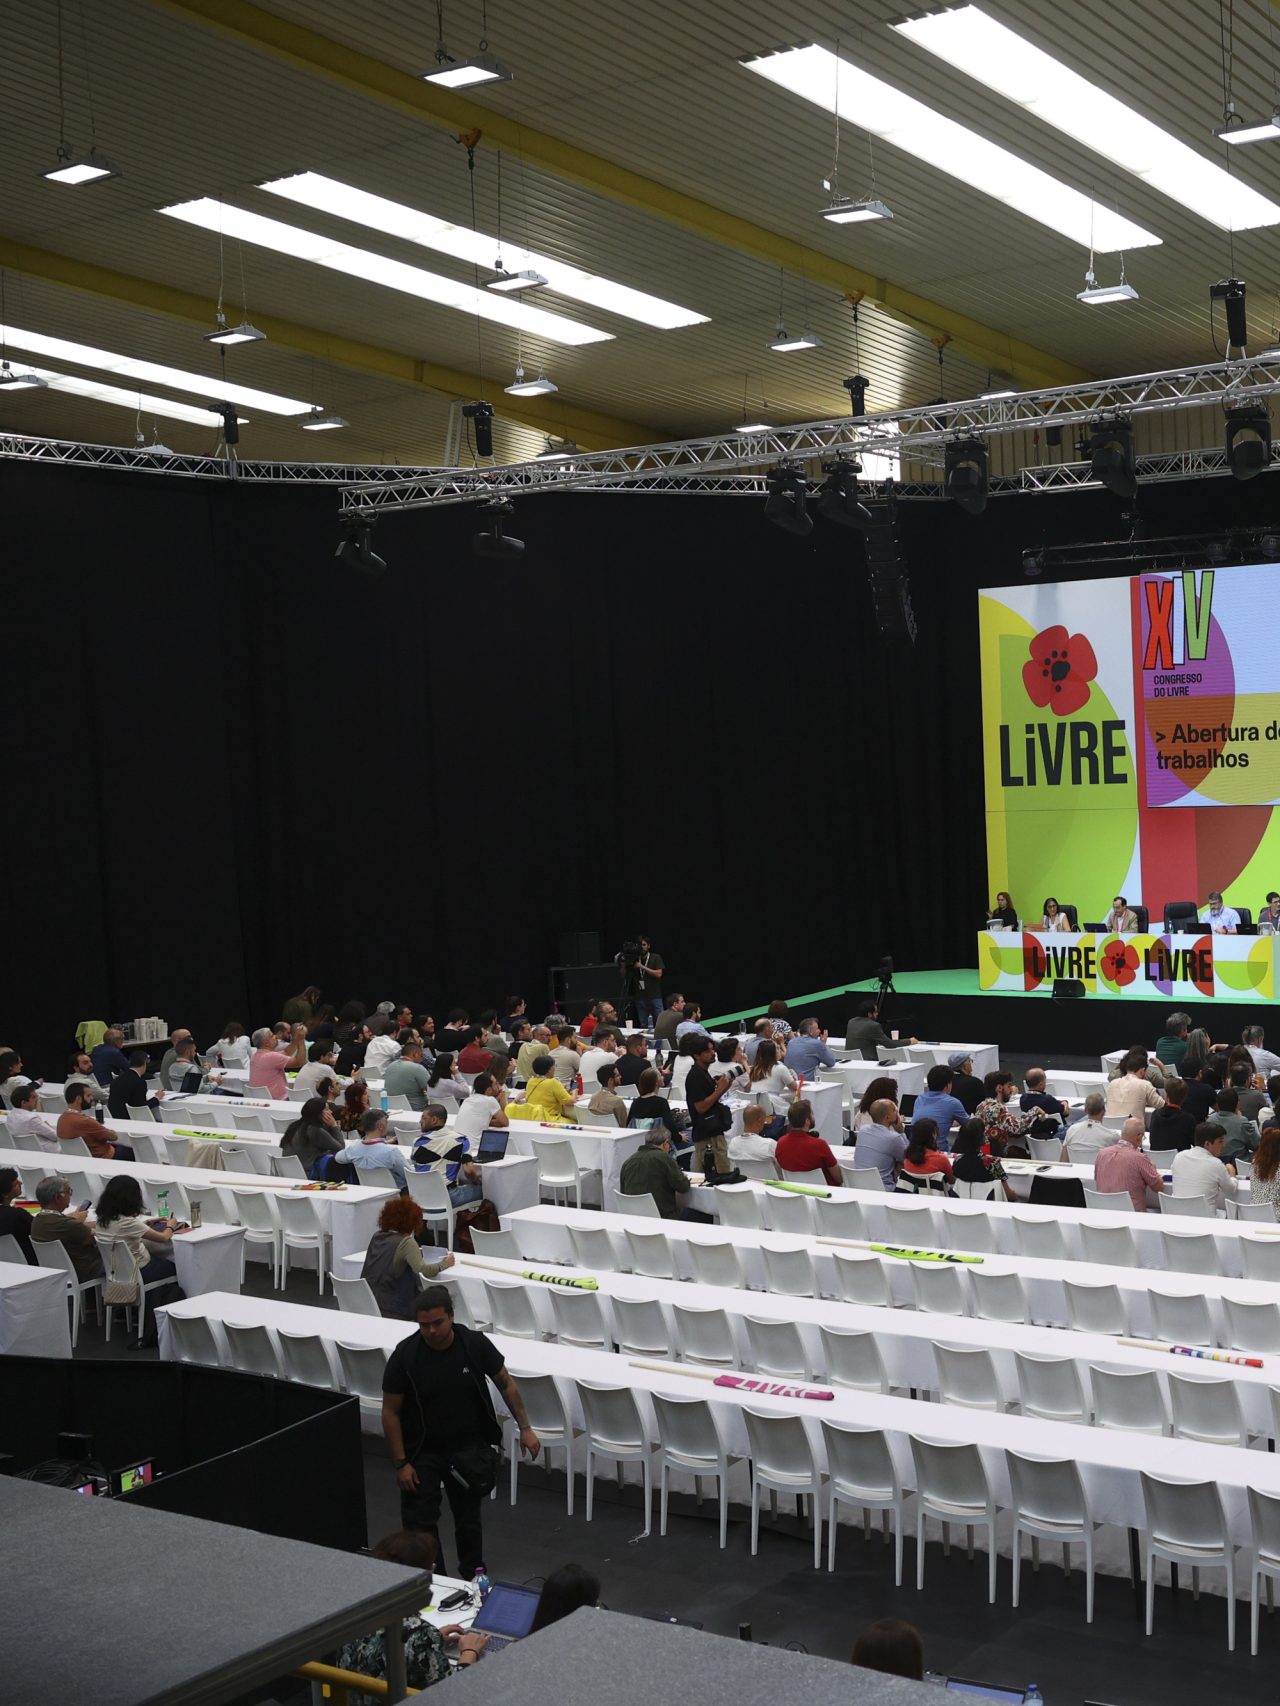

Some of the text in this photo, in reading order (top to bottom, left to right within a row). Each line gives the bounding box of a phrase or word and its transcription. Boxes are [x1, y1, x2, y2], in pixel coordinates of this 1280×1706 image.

[1143, 570, 1215, 670] XIV
[1154, 673, 1202, 685] CONGRESSO
[1154, 686, 1190, 697] DO LIVRE
[1171, 722, 1259, 743] Abertura
[1000, 720, 1128, 787] LiVRE
[1156, 749, 1250, 770] trabalhos
[1032, 945, 1213, 982] LiVRE LiVRE
